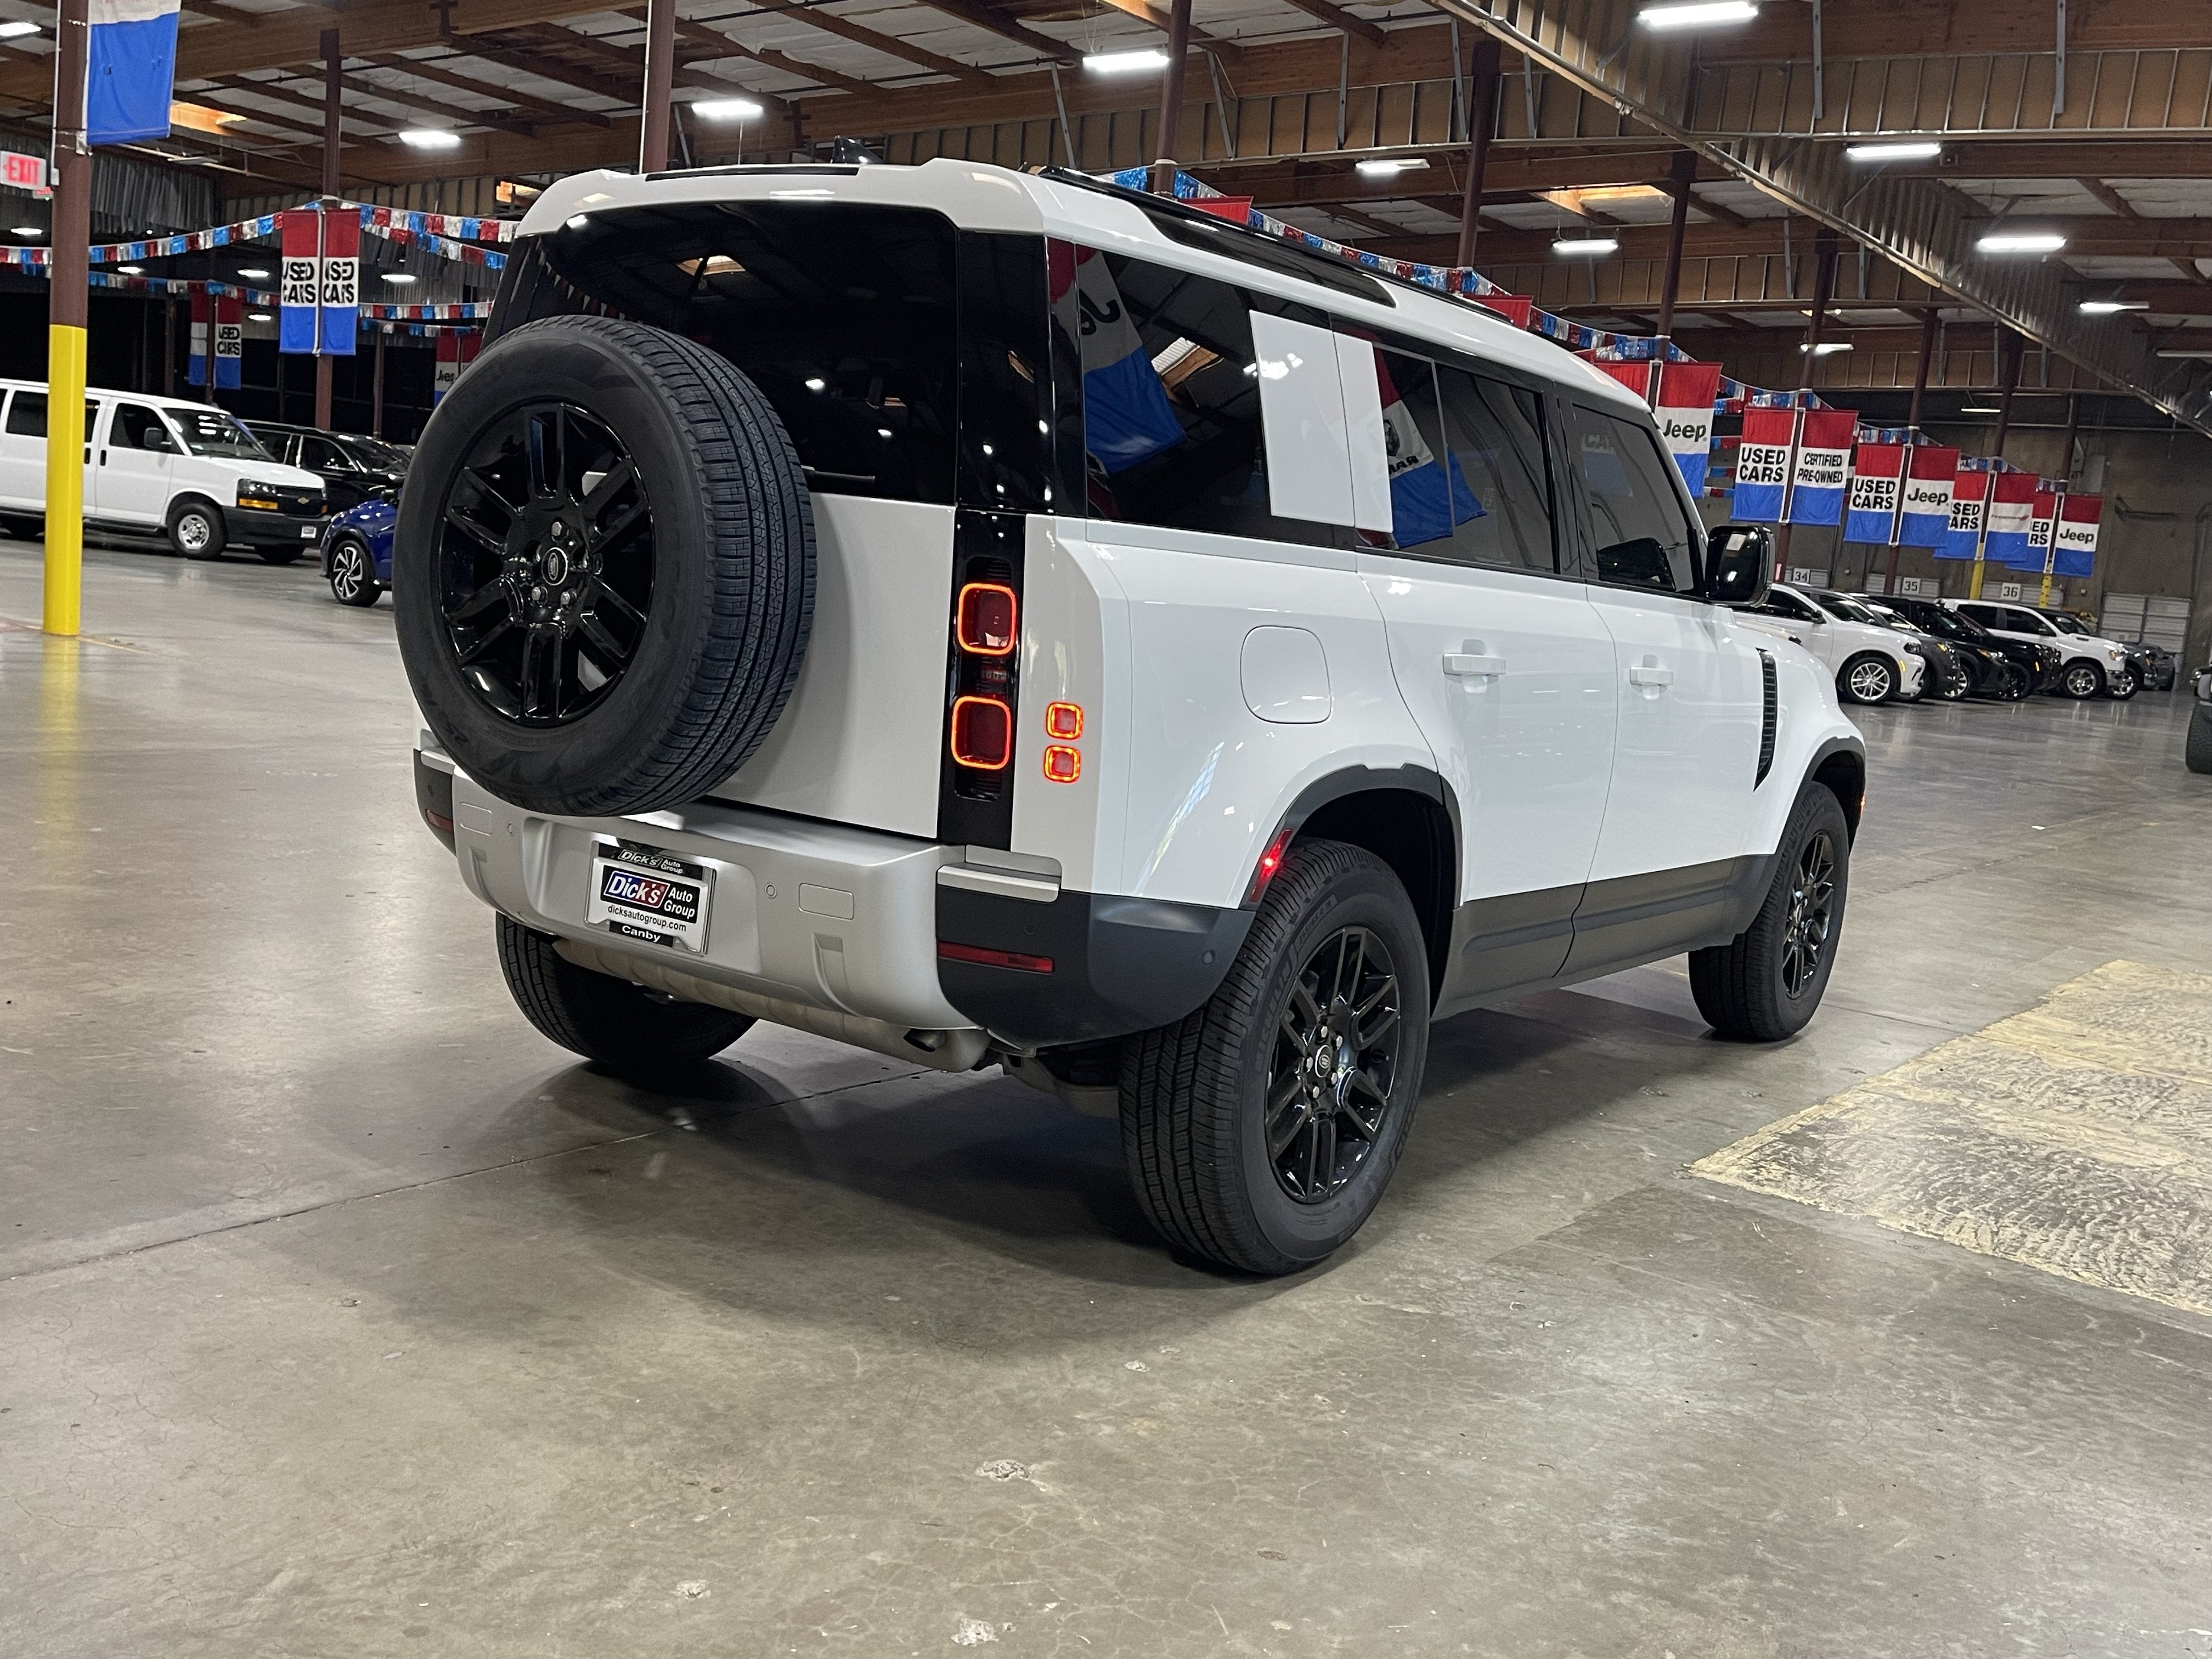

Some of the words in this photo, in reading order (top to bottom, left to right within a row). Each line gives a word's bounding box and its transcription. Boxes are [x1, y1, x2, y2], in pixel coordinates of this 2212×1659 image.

[8, 155, 40, 185] EXIT
[1663, 419, 1706, 442] Jeep
[1741, 447, 1786, 465] USED
[1804, 452, 1842, 466] CERTIFIED
[1740, 464, 1784, 482] CARS
[1797, 468, 1843, 483] PRE-OWNED
[1855, 478, 1896, 494] USED
[1852, 494, 1894, 510] CARS
[1908, 487, 1949, 506] Jeep
[1952, 502, 1980, 516] SED
[1949, 516, 1978, 529] ARS
[2032, 521, 2050, 533] ED
[2029, 533, 2048, 545] RS
[2059, 528, 2095, 544] Jeep
[1795, 571, 1807, 582] 34
[1904, 581, 1918, 591] 35
[2003, 586, 2019, 597] 36
[621, 851, 658, 866] Dick's
[663, 859, 681, 867] Auto
[661, 864, 683, 874] Group
[608, 876, 661, 904] Dick's
[668, 887, 693, 902] Auto
[664, 900, 696, 919] Group
[607, 904, 687, 932] dicksautogroup.com
[622, 925, 661, 943] Canby
